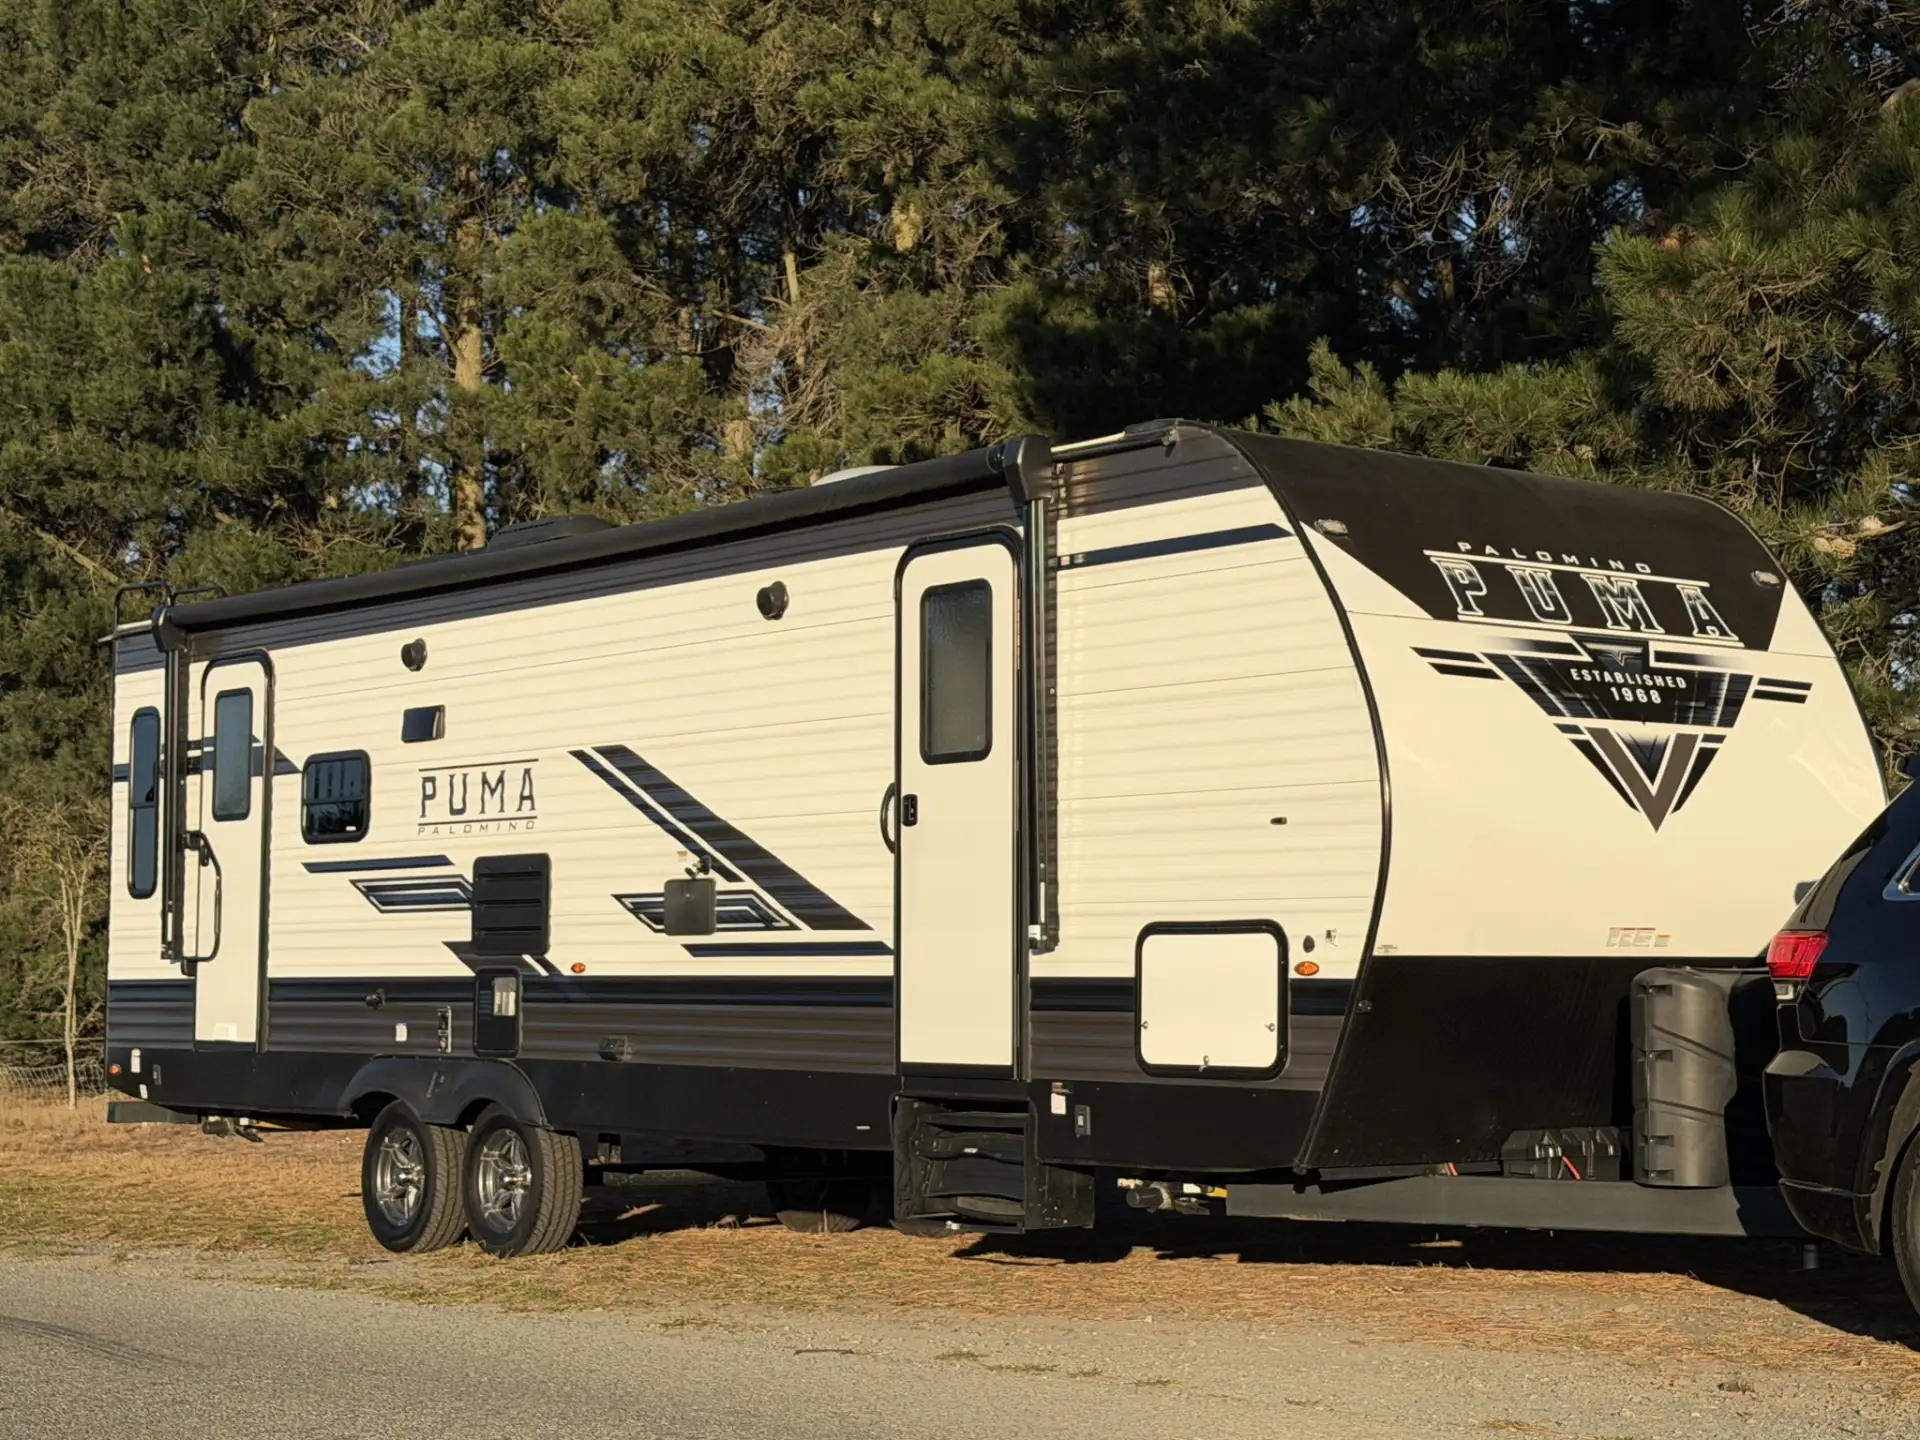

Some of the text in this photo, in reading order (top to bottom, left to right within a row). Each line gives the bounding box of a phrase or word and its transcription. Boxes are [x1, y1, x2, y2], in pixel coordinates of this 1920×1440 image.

[1456, 541, 1653, 574] PALOMINO
[1430, 555, 1740, 641] PUMA
[1570, 667, 1688, 690] ESTABLISHED
[1610, 686, 1663, 705] 1968
[419, 767, 537, 819] PUMA
[417, 820, 536, 836] PALOMINO
